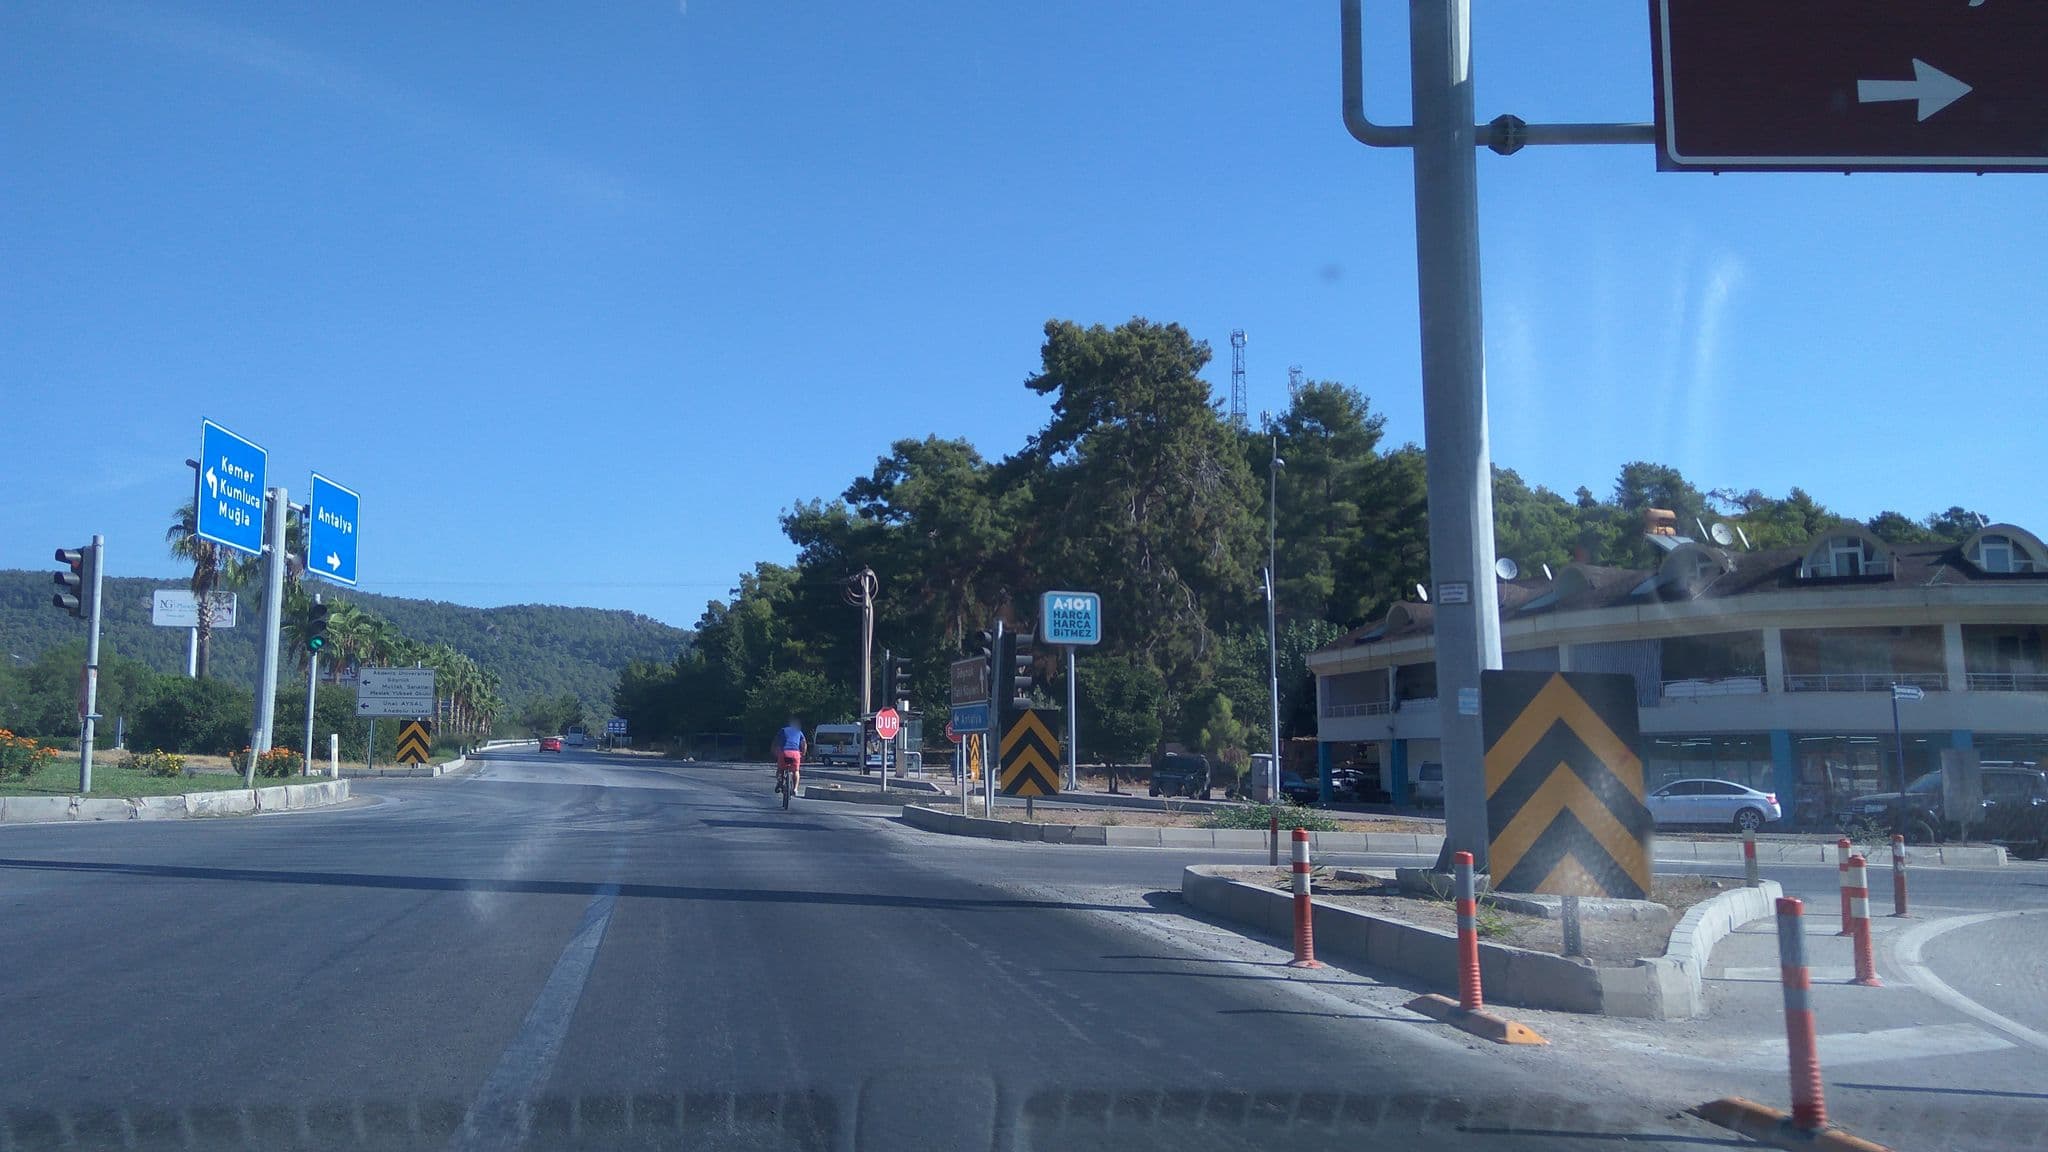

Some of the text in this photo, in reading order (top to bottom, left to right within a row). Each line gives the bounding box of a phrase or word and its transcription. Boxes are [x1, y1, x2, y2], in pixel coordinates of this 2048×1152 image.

[221, 455, 255, 484] Kemer
[219, 478, 261, 510] Kumluca
[218, 500, 251, 527] Muğla
[317, 505, 353, 535] Antalya
[1053, 610, 1091, 620] HARCA
[1053, 619, 1091, 629] HARCA
[877, 716, 898, 730] DUR
